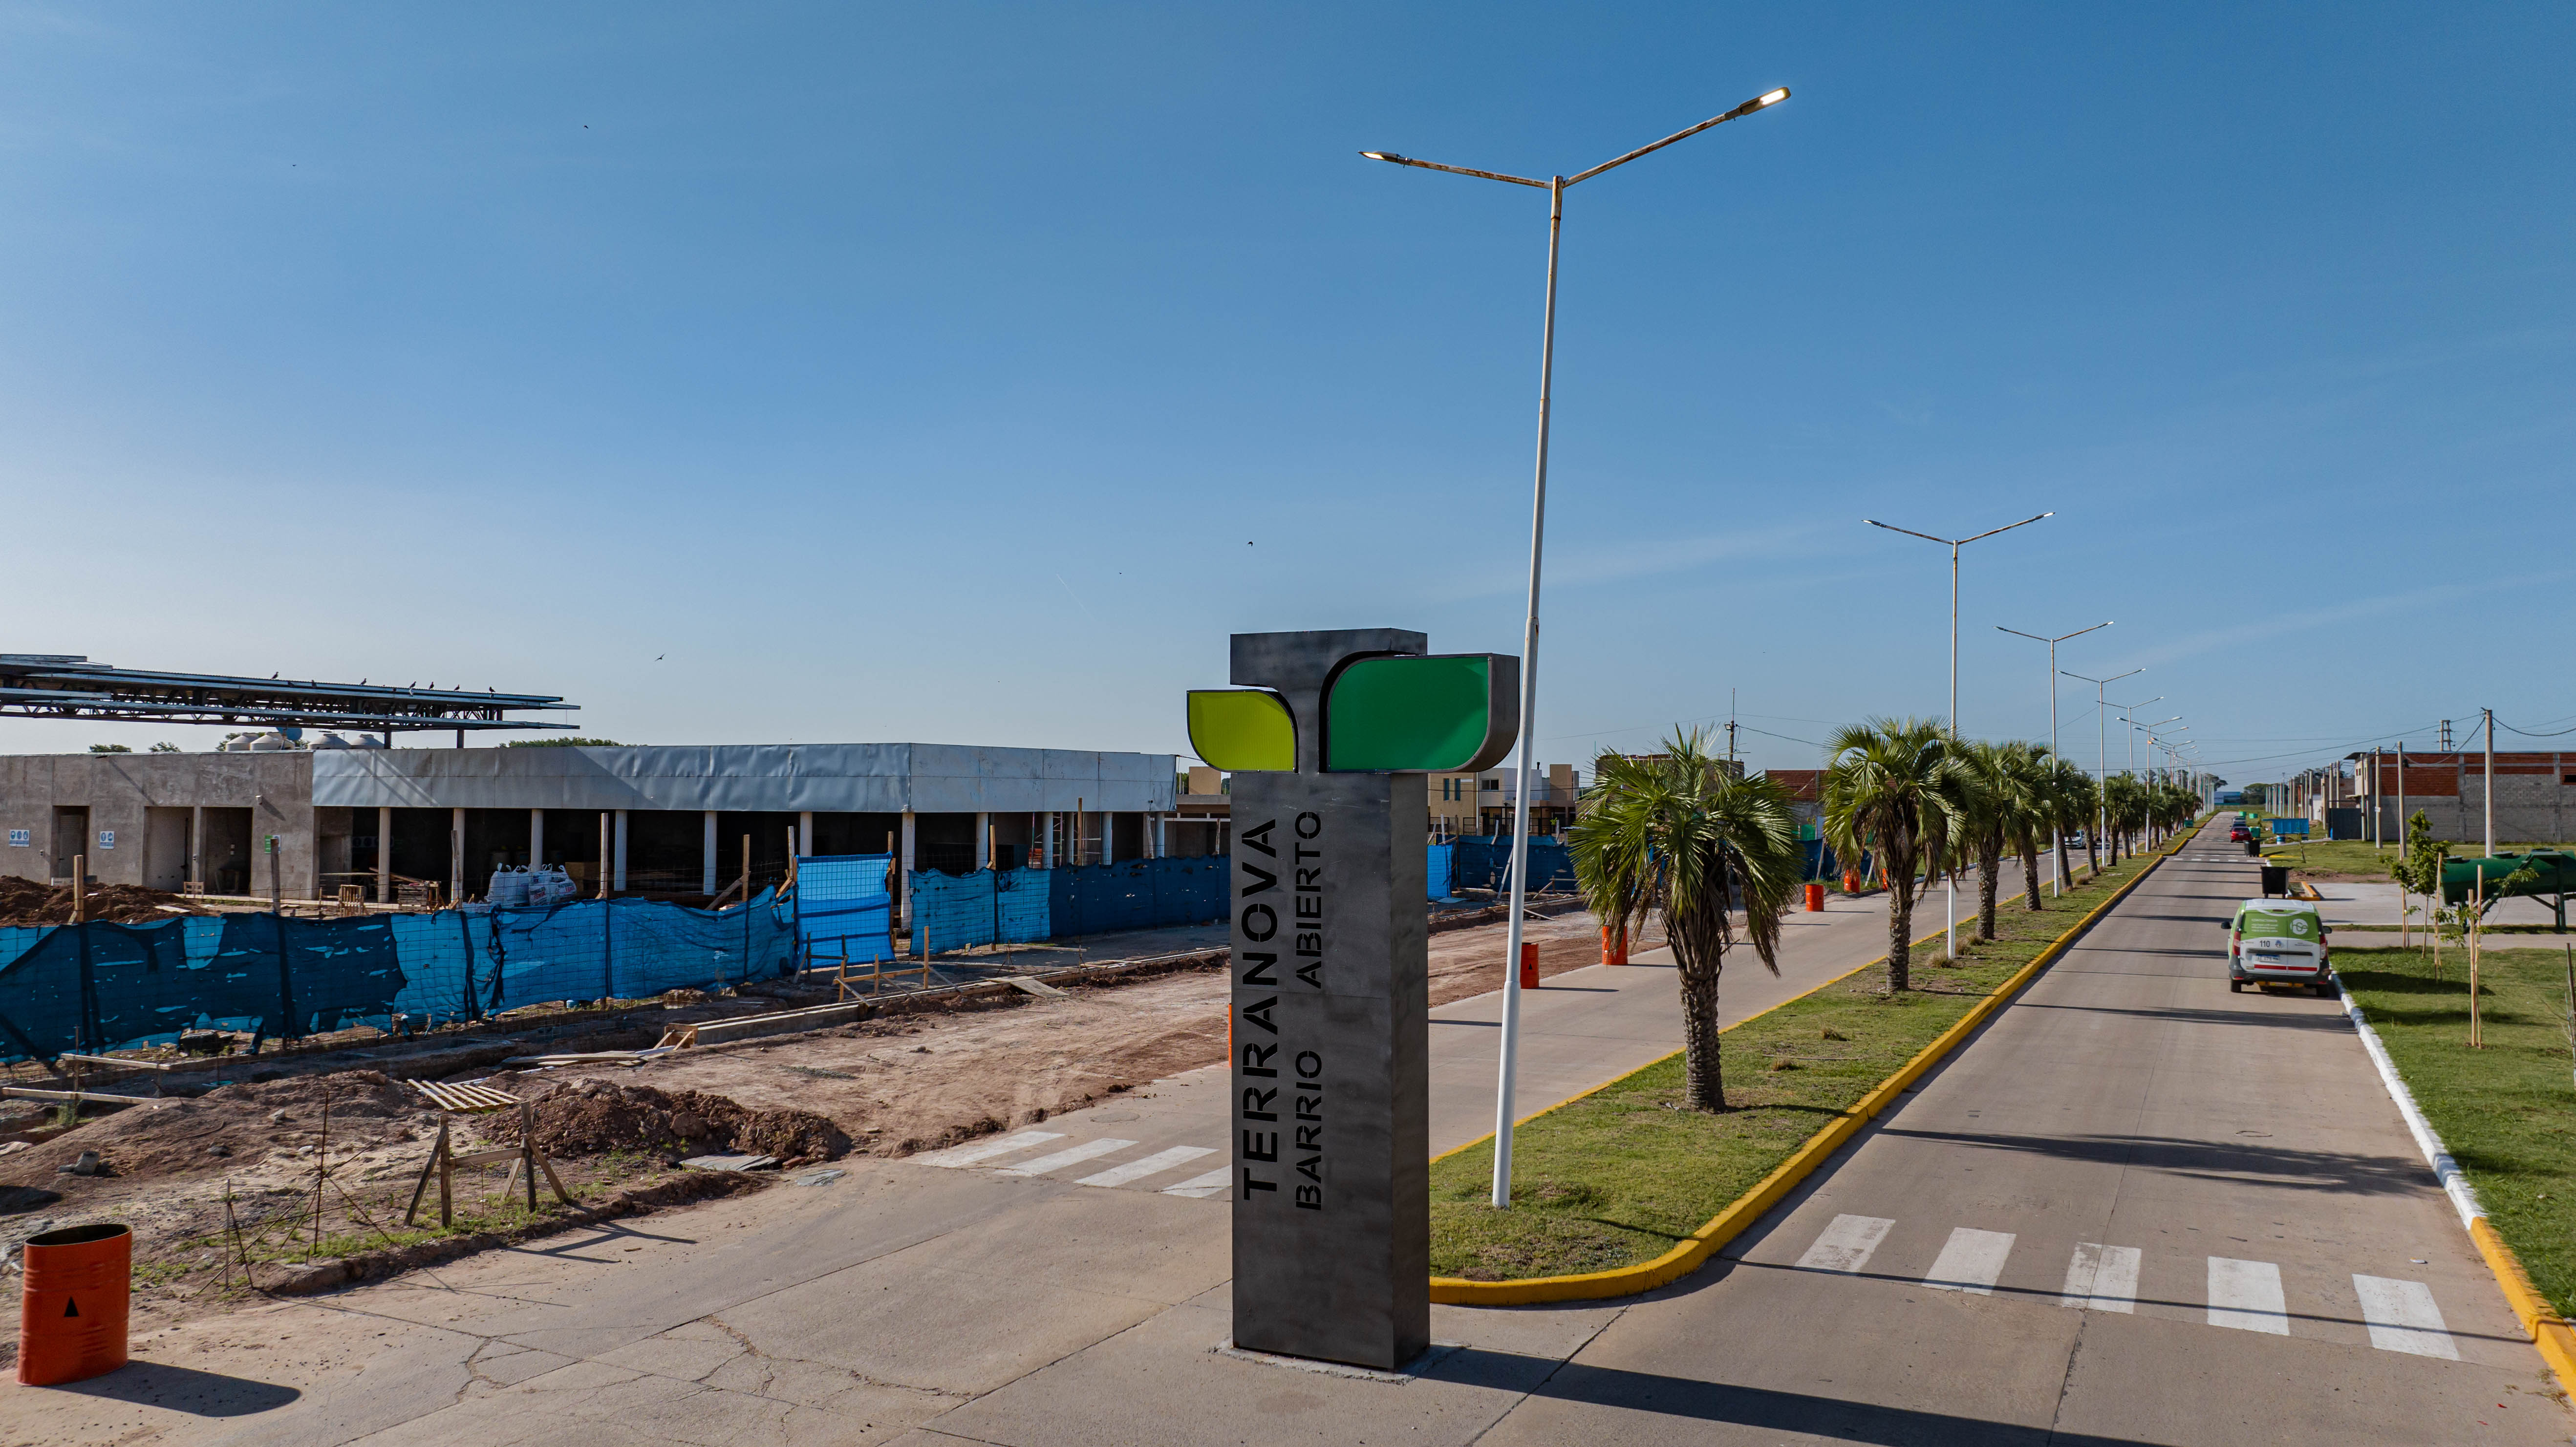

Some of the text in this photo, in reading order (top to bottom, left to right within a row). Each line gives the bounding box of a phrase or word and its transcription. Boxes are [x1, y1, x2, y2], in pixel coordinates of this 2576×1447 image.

[1241, 819, 1278, 1200] TERRANOVA
[1295, 811, 1322, 1211] BARRIO ABIERTO
